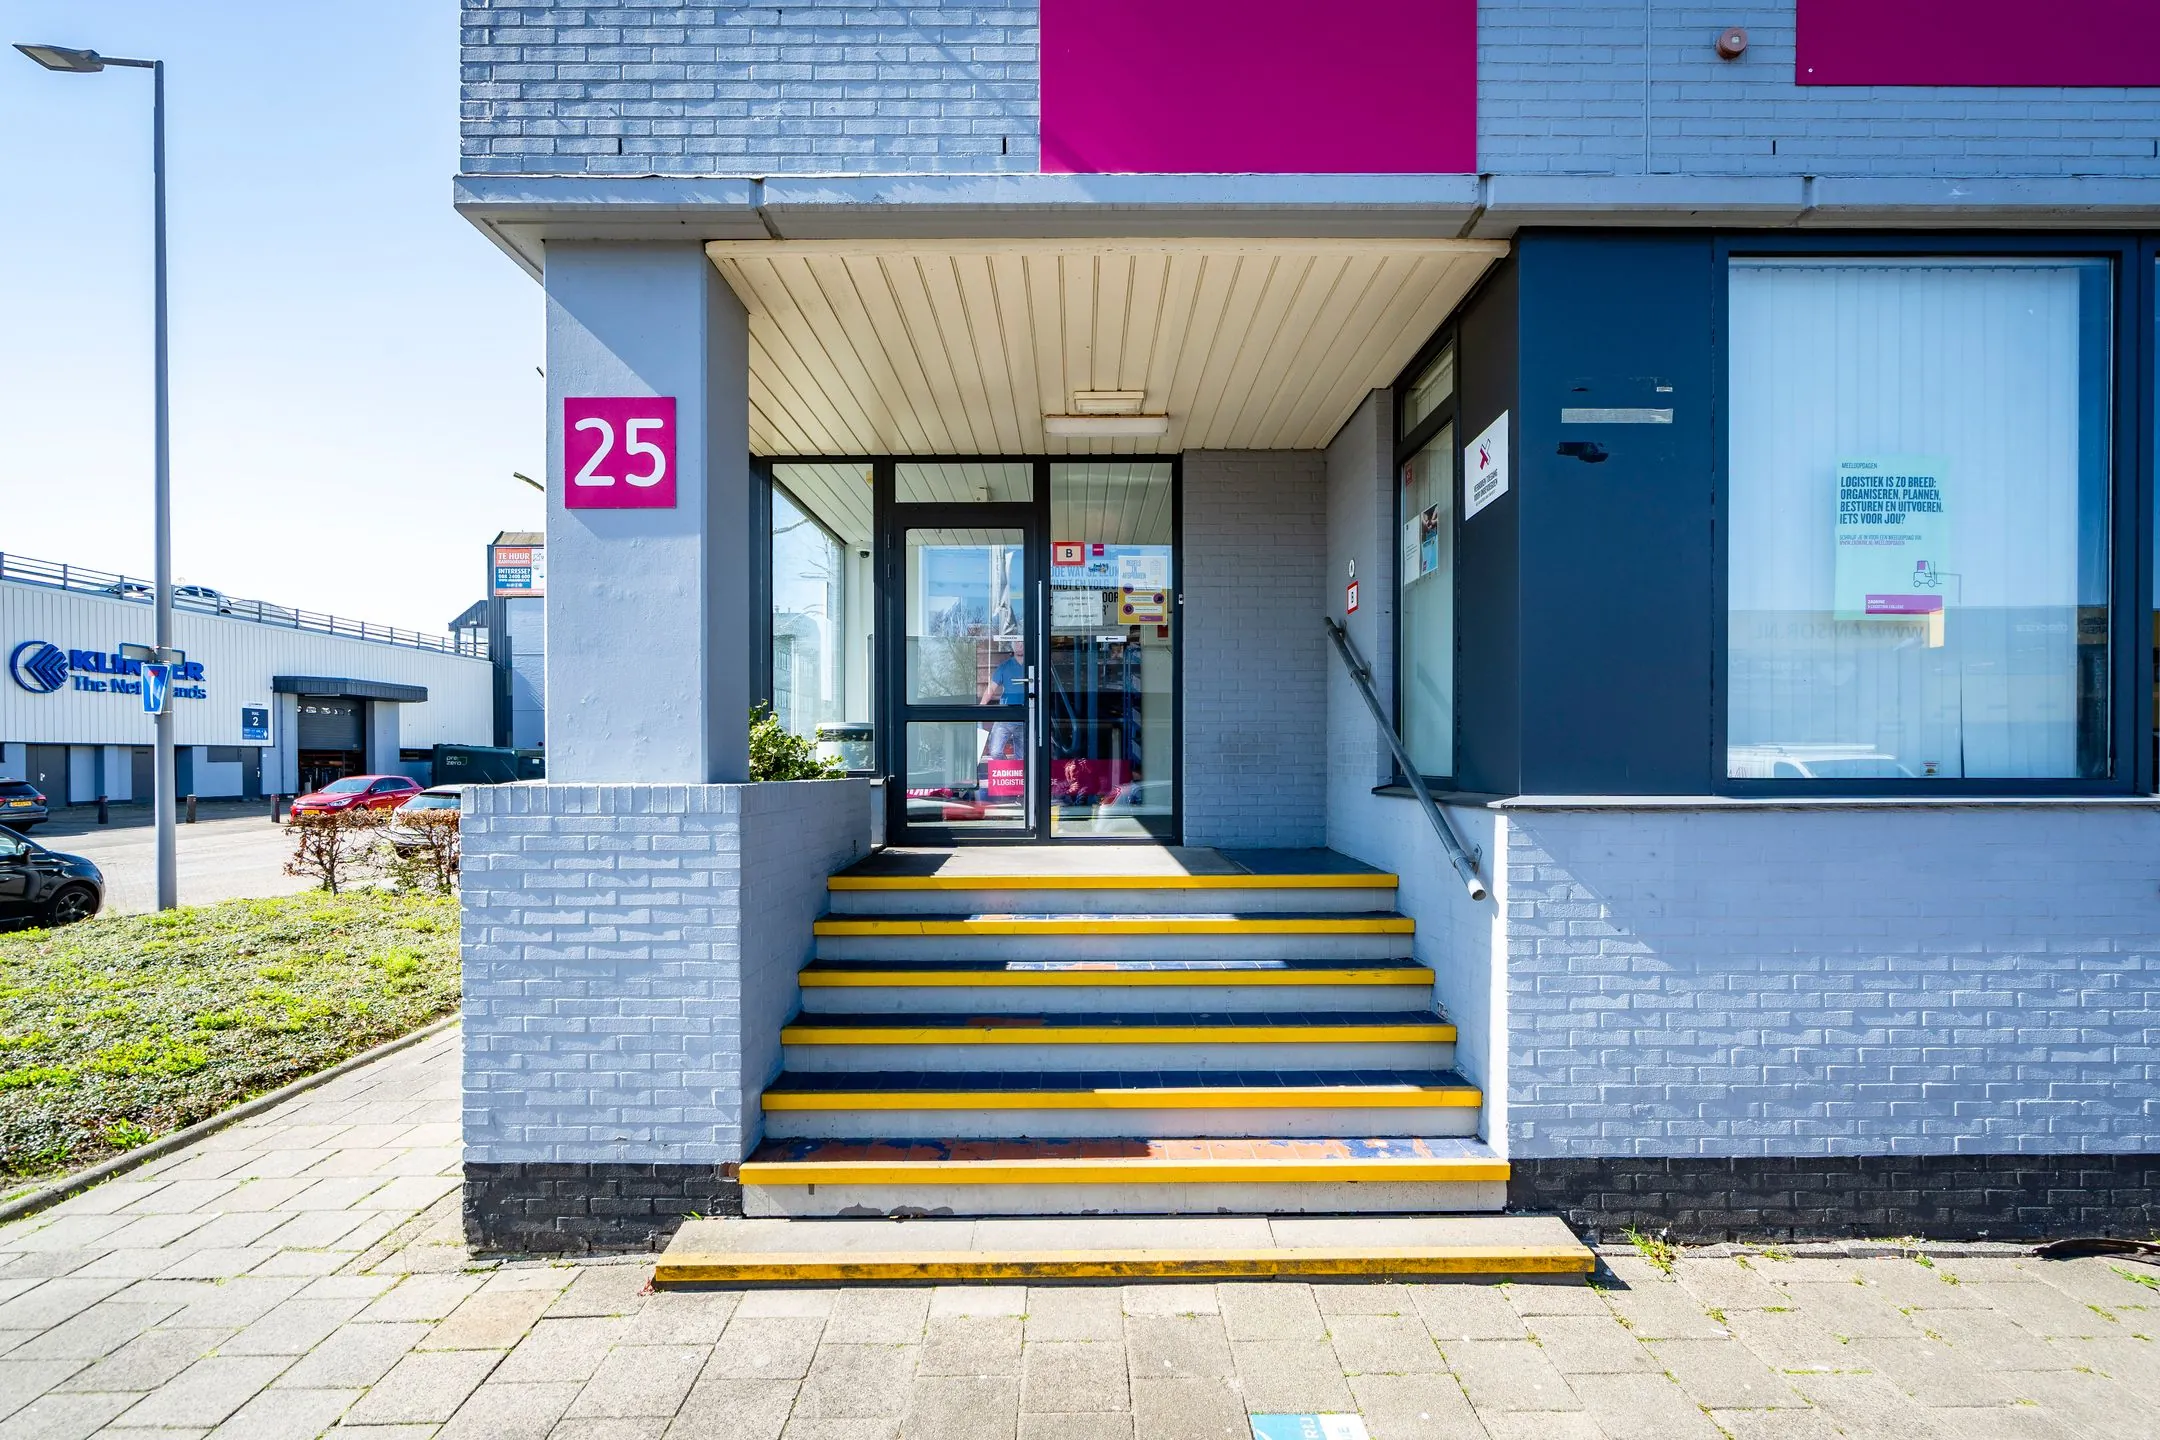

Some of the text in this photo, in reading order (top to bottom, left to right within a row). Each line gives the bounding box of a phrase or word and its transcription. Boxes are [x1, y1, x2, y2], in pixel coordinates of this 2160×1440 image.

[574, 417, 666, 487] 25
[1841, 476, 1937, 488] LOGISTIEK IS ZO BREED:
[1840, 488, 1942, 502] ORGANISEREN, PLANNEN,
[1840, 501, 1944, 513] BESTUREN EN UITVOEREN.
[1839, 513, 1906, 525] IETS VOOR JOU?
[498, 552, 530, 560] TE HUUR
[1065, 548, 1073, 558] B
[69, 649, 206, 682] KLINER
[70, 675, 207, 700] The Netands
[252, 716, 259, 726] 2
[992, 769, 1023, 777] ZADKINE
[997, 778, 1024, 786] LOGISTIE
